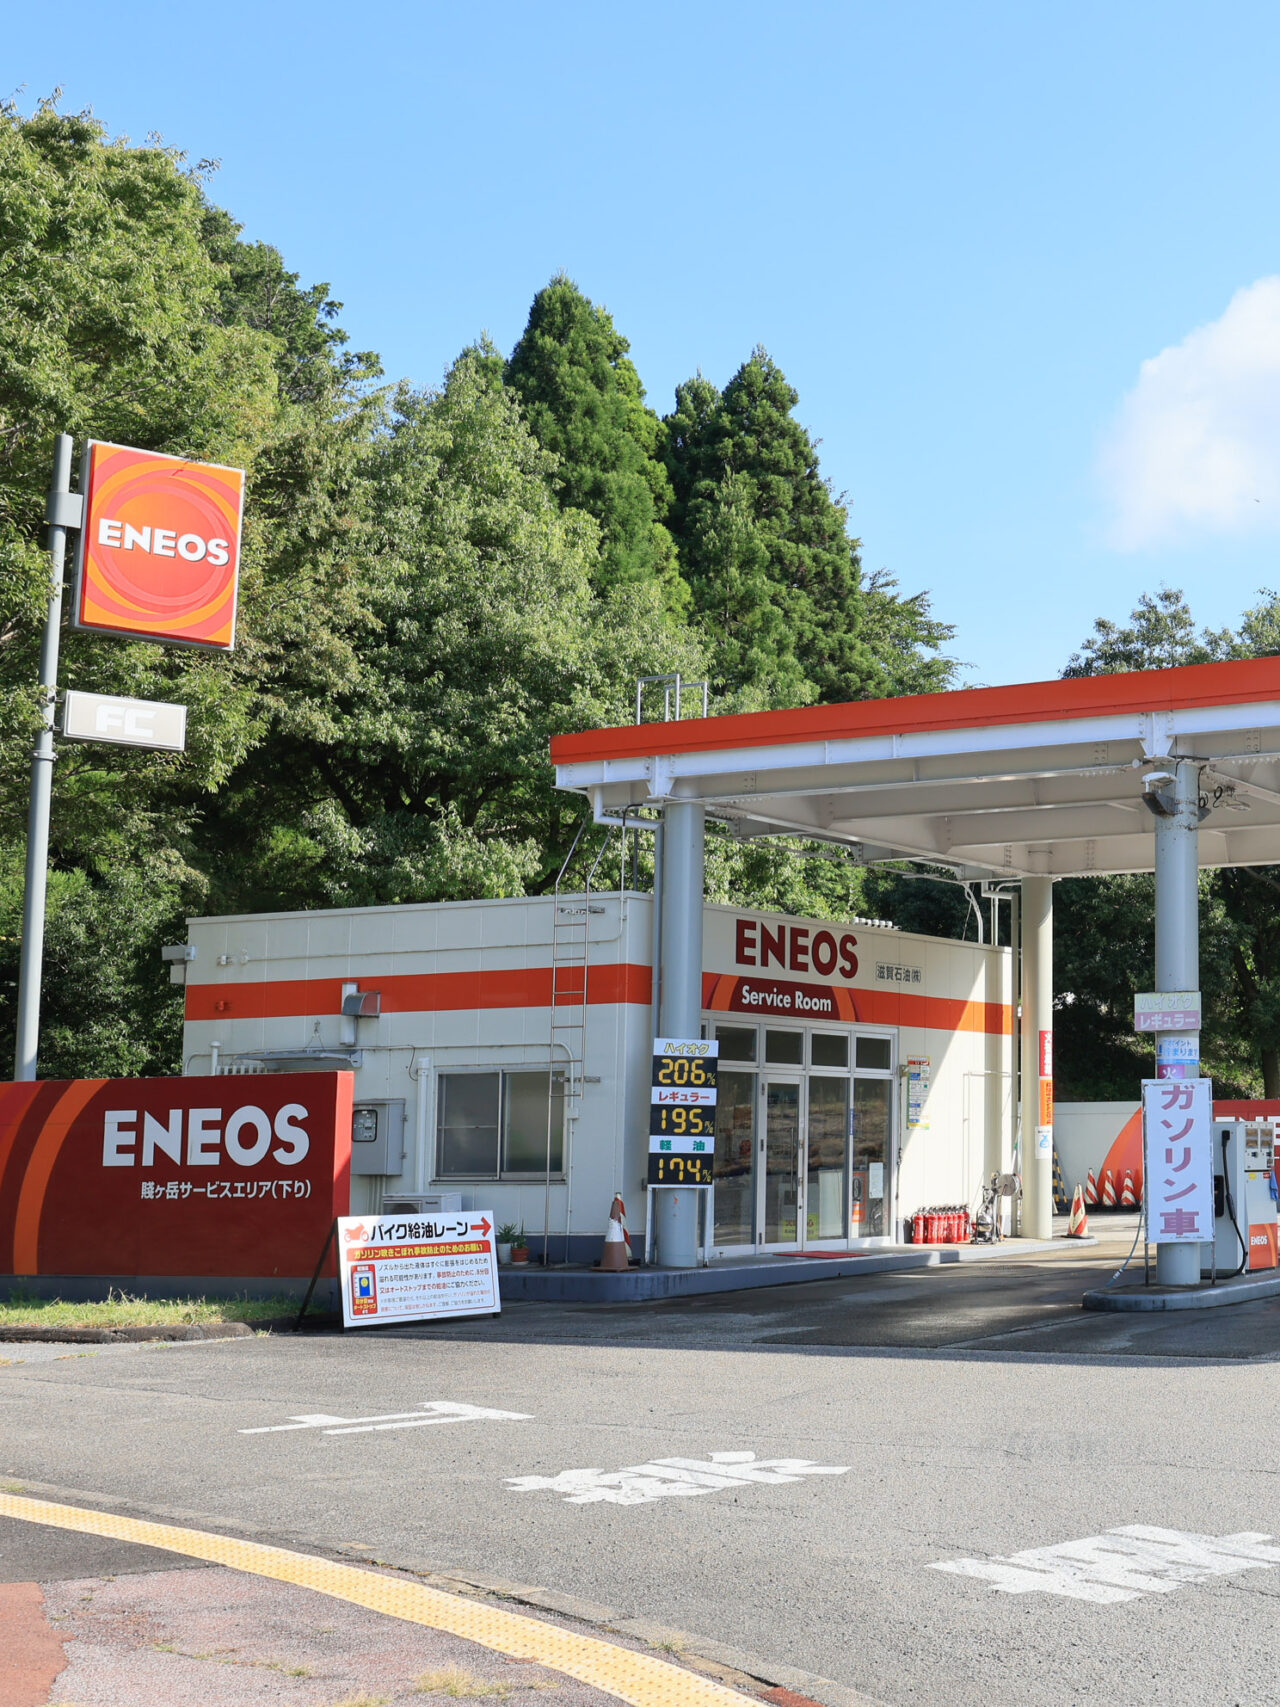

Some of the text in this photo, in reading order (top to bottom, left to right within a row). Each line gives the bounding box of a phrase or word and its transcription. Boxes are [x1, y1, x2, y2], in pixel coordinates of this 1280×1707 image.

[98, 518, 230, 566] ENEOS
[95, 704, 157, 738] FC
[736, 919, 859, 979] ENEOS
[742, 985, 832, 1012] Service Room
[1140, 1014, 1196, 1029] レギュラー
[664, 1043, 709, 1055] ハイオク
[659, 1059, 706, 1084] 206
[659, 1091, 710, 1103] レギュラー
[661, 1108, 703, 1133] 195
[102, 1103, 310, 1167] ENEOS
[660, 1140, 706, 1152] 軽油
[658, 1158, 701, 1181] 174
[1159, 1085, 1200, 1236] ガソリン車
[371, 1221, 468, 1241] バイク給油レーン
[1250, 1235, 1268, 1245] ENEOS
